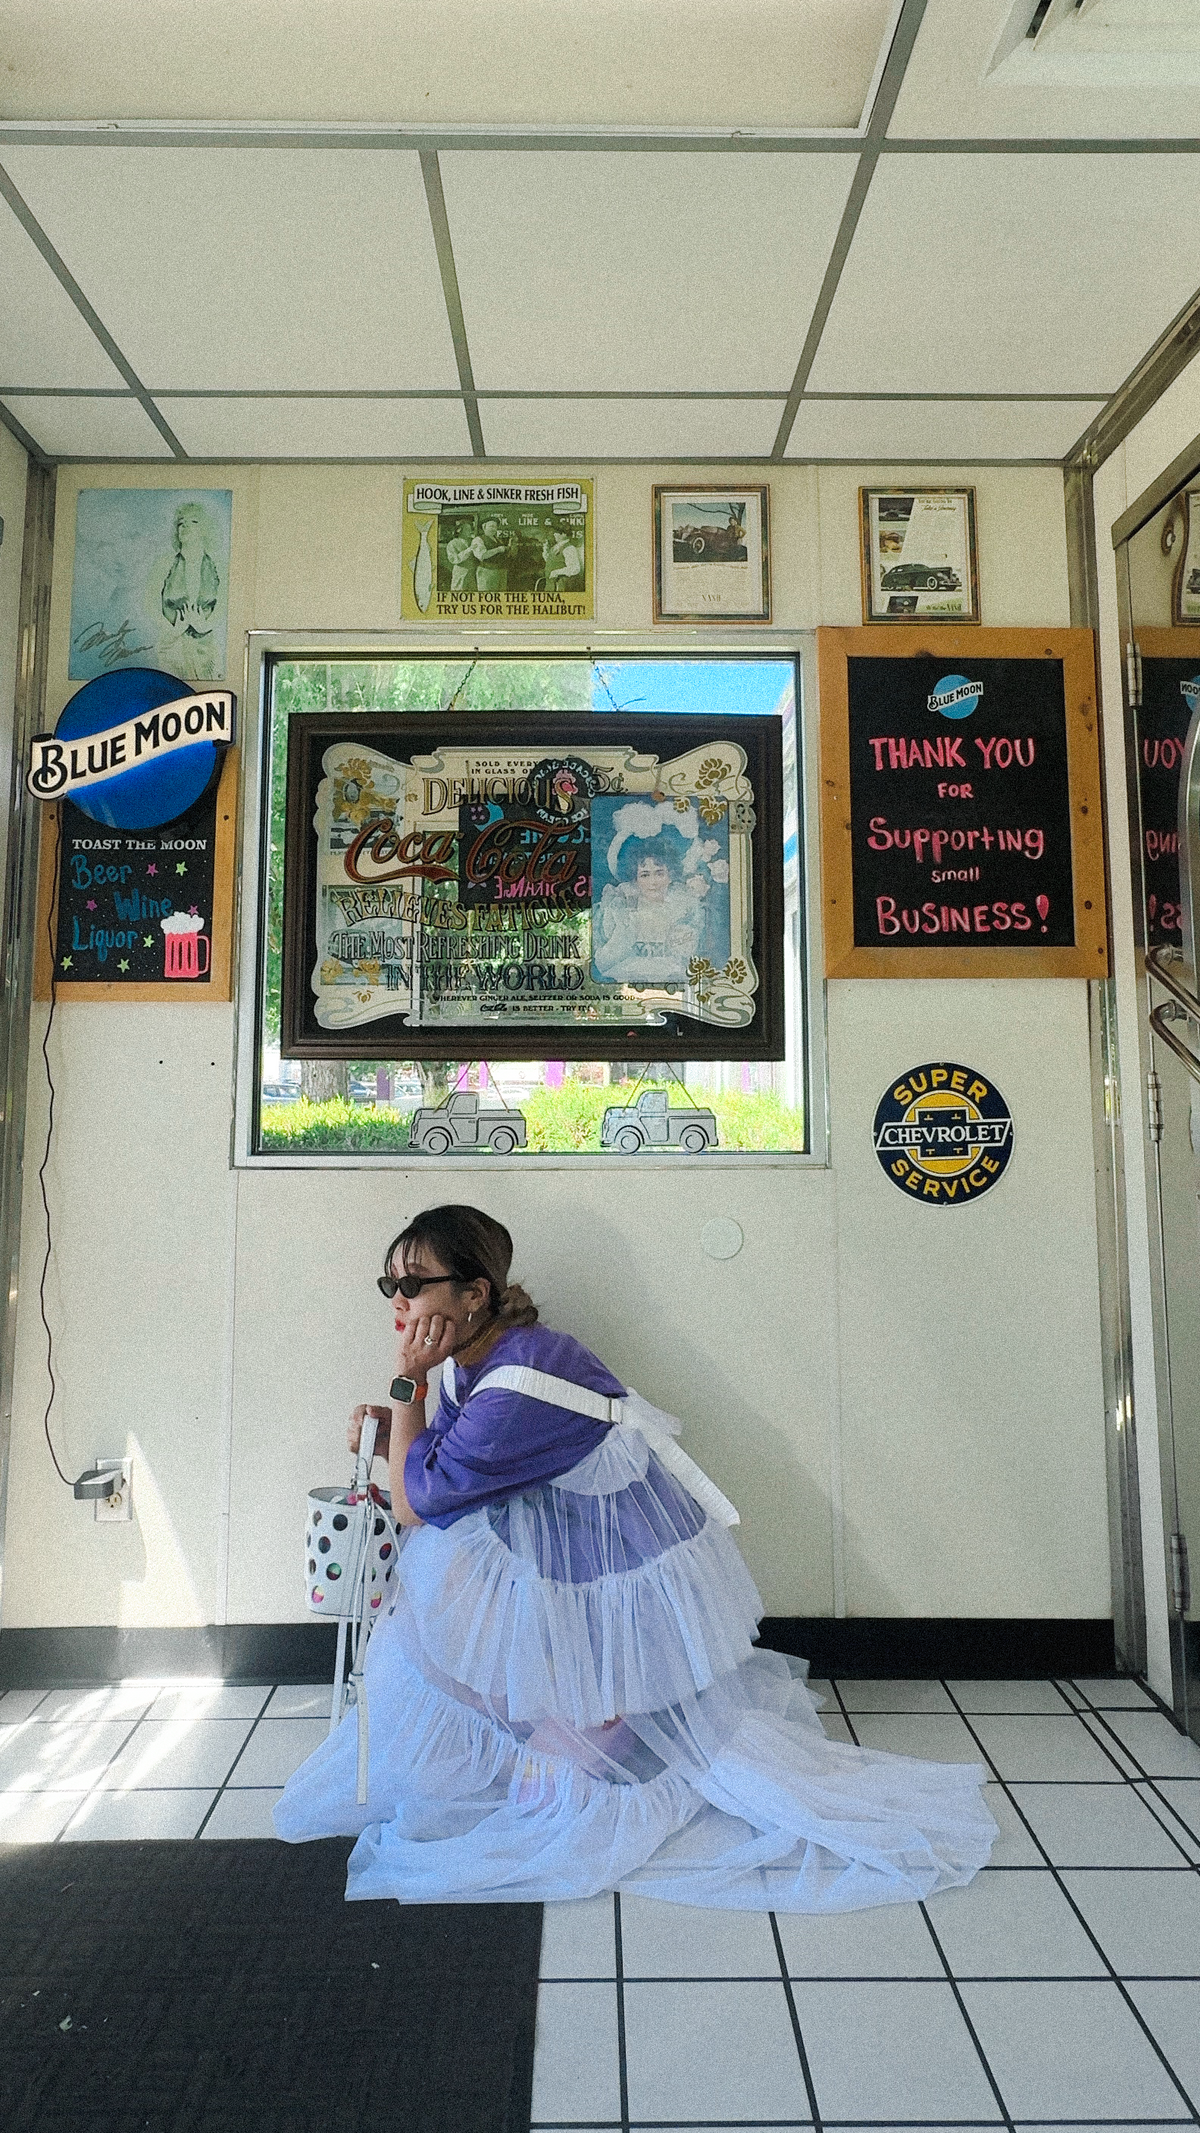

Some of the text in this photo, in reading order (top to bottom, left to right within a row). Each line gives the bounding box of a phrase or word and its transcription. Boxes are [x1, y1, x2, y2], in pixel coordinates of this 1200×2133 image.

[416, 487, 578, 501] HOOK, LINE & SINKER FRESH FISH
[436, 604, 586, 614] TRY US FOR THE HALIBUT!
[437, 593, 565, 603] IF NOT FOR THE TUNA,
[928, 684, 982, 709] BLUE MOON
[32, 701, 226, 793] BLUE MOON
[868, 736, 1035, 771] THANK YOU
[421, 777, 575, 816] DELICIOUS
[937, 782, 974, 798] FOR
[72, 839, 207, 850] TOAST THE MOON
[70, 854, 132, 890] Beer
[931, 865, 980, 883] small
[113, 888, 174, 922] Wine
[330, 886, 587, 932] RELIEVES FATIGUE
[72, 915, 138, 962] Liquor
[335, 931, 581, 962] THE MOST REFRESHING DRINK
[387, 964, 413, 991] IN
[418, 964, 472, 991] THE
[893, 1068, 988, 1106] SUPER
[884, 1125, 1004, 1144] CHEVROLET
[891, 1155, 1000, 1198] SERVICE
